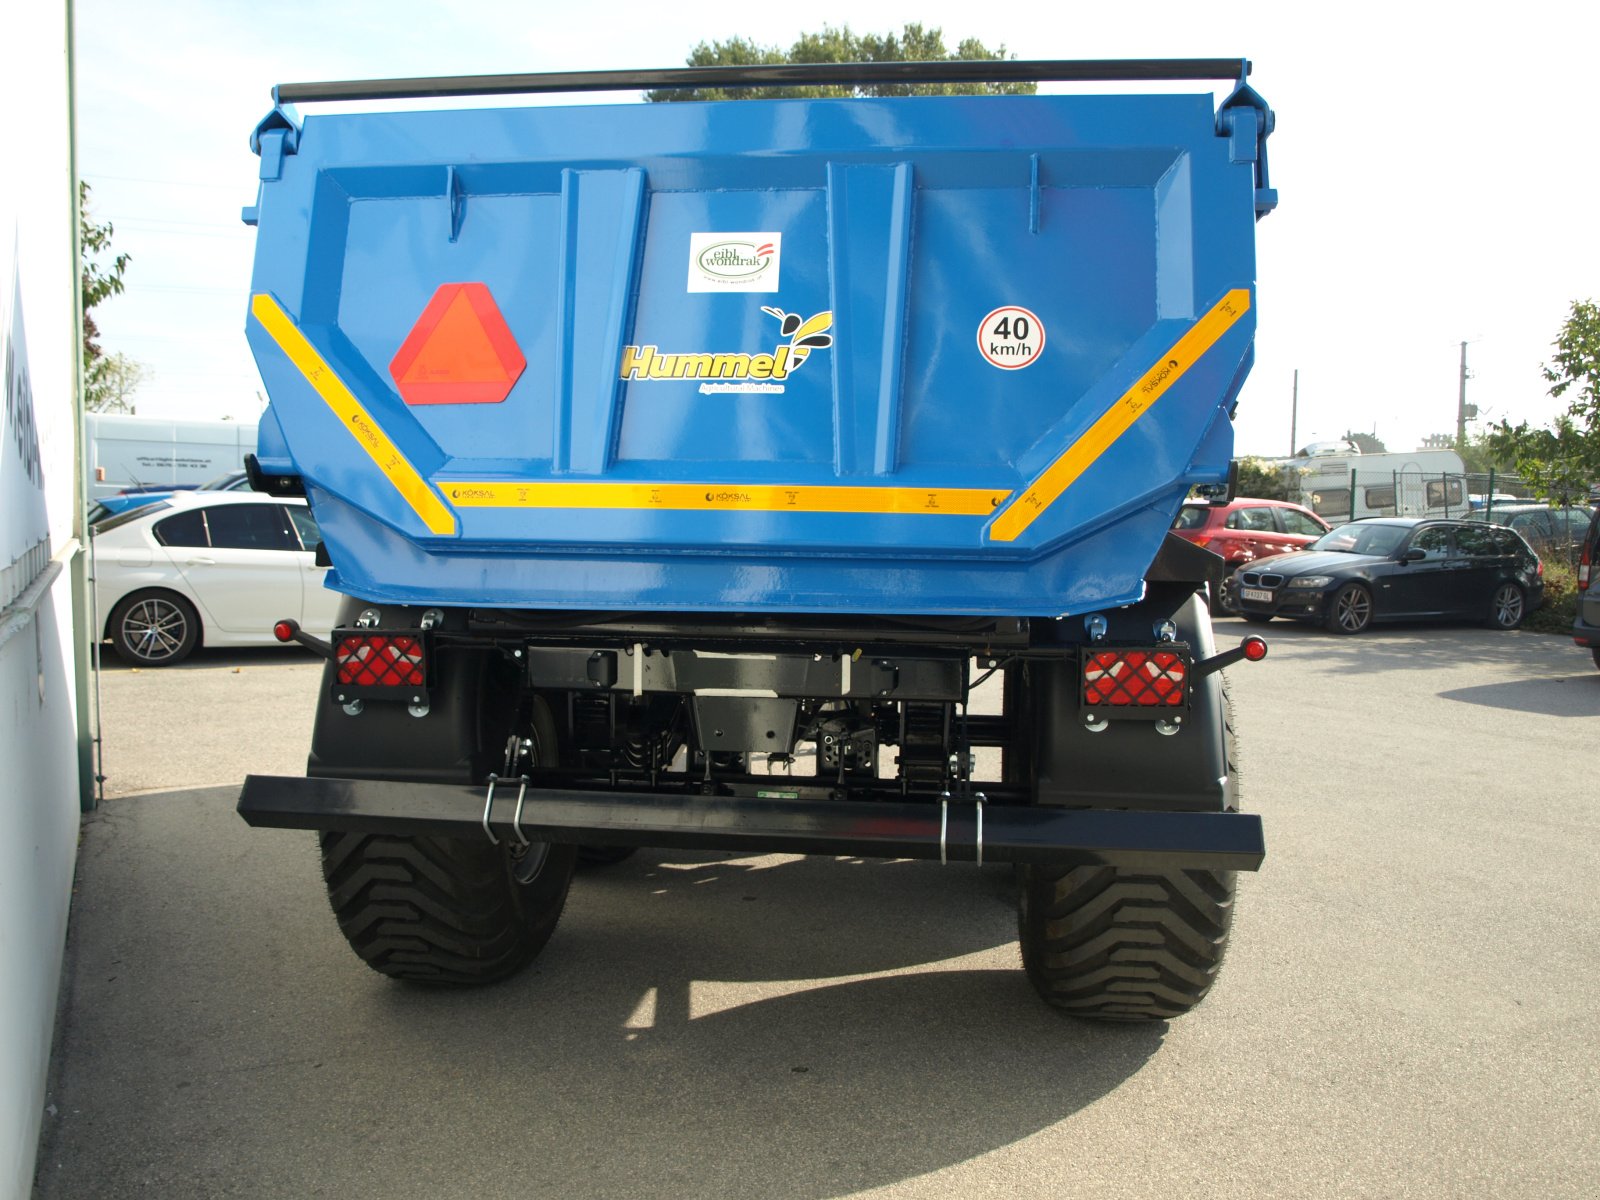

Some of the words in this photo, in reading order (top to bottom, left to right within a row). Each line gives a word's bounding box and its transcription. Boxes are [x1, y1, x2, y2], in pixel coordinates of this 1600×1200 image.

[713, 248, 737, 261] eibl
[705, 256, 761, 267] wondrak
[993, 316, 1029, 340] 40
[990, 342, 1031, 356] km/h
[620, 346, 789, 379] Hummel
[746, 383, 784, 393] Machines
